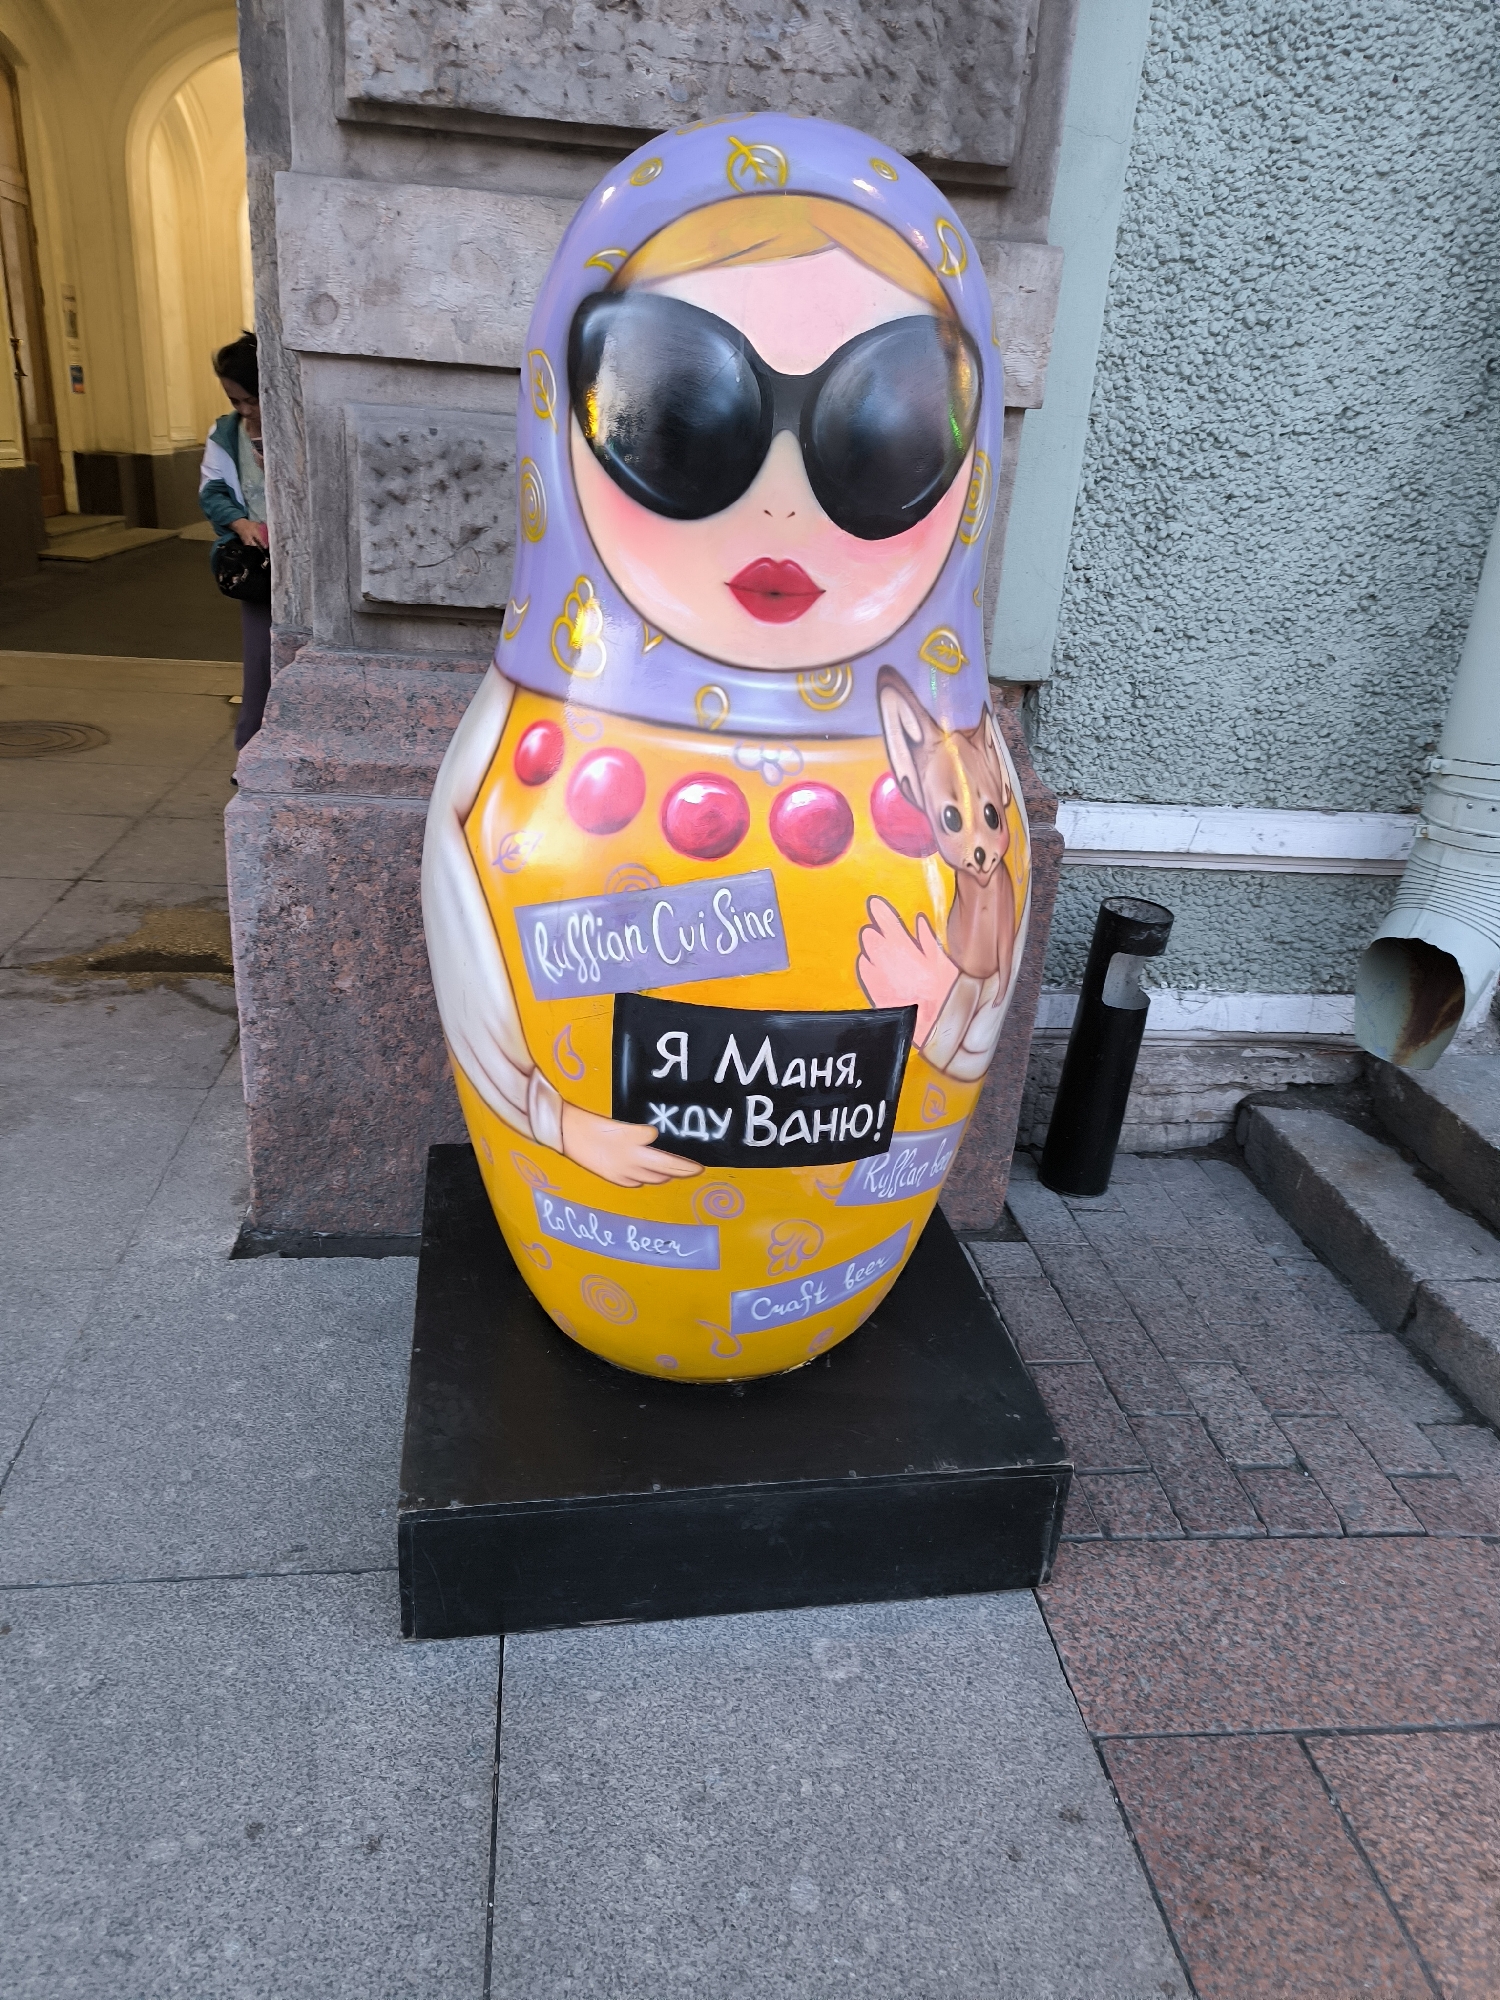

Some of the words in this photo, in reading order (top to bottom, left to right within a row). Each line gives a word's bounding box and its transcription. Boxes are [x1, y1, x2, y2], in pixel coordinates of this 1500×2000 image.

[651, 1031, 689, 1081] Я
[713, 1033, 863, 1089] Маня,
[649, 1101, 733, 1141] жду
[743, 1094, 886, 1147] Ваню!
[626, 1224, 705, 1257] beer
[751, 1280, 829, 1321] Craft
[843, 1252, 895, 1290] beer
